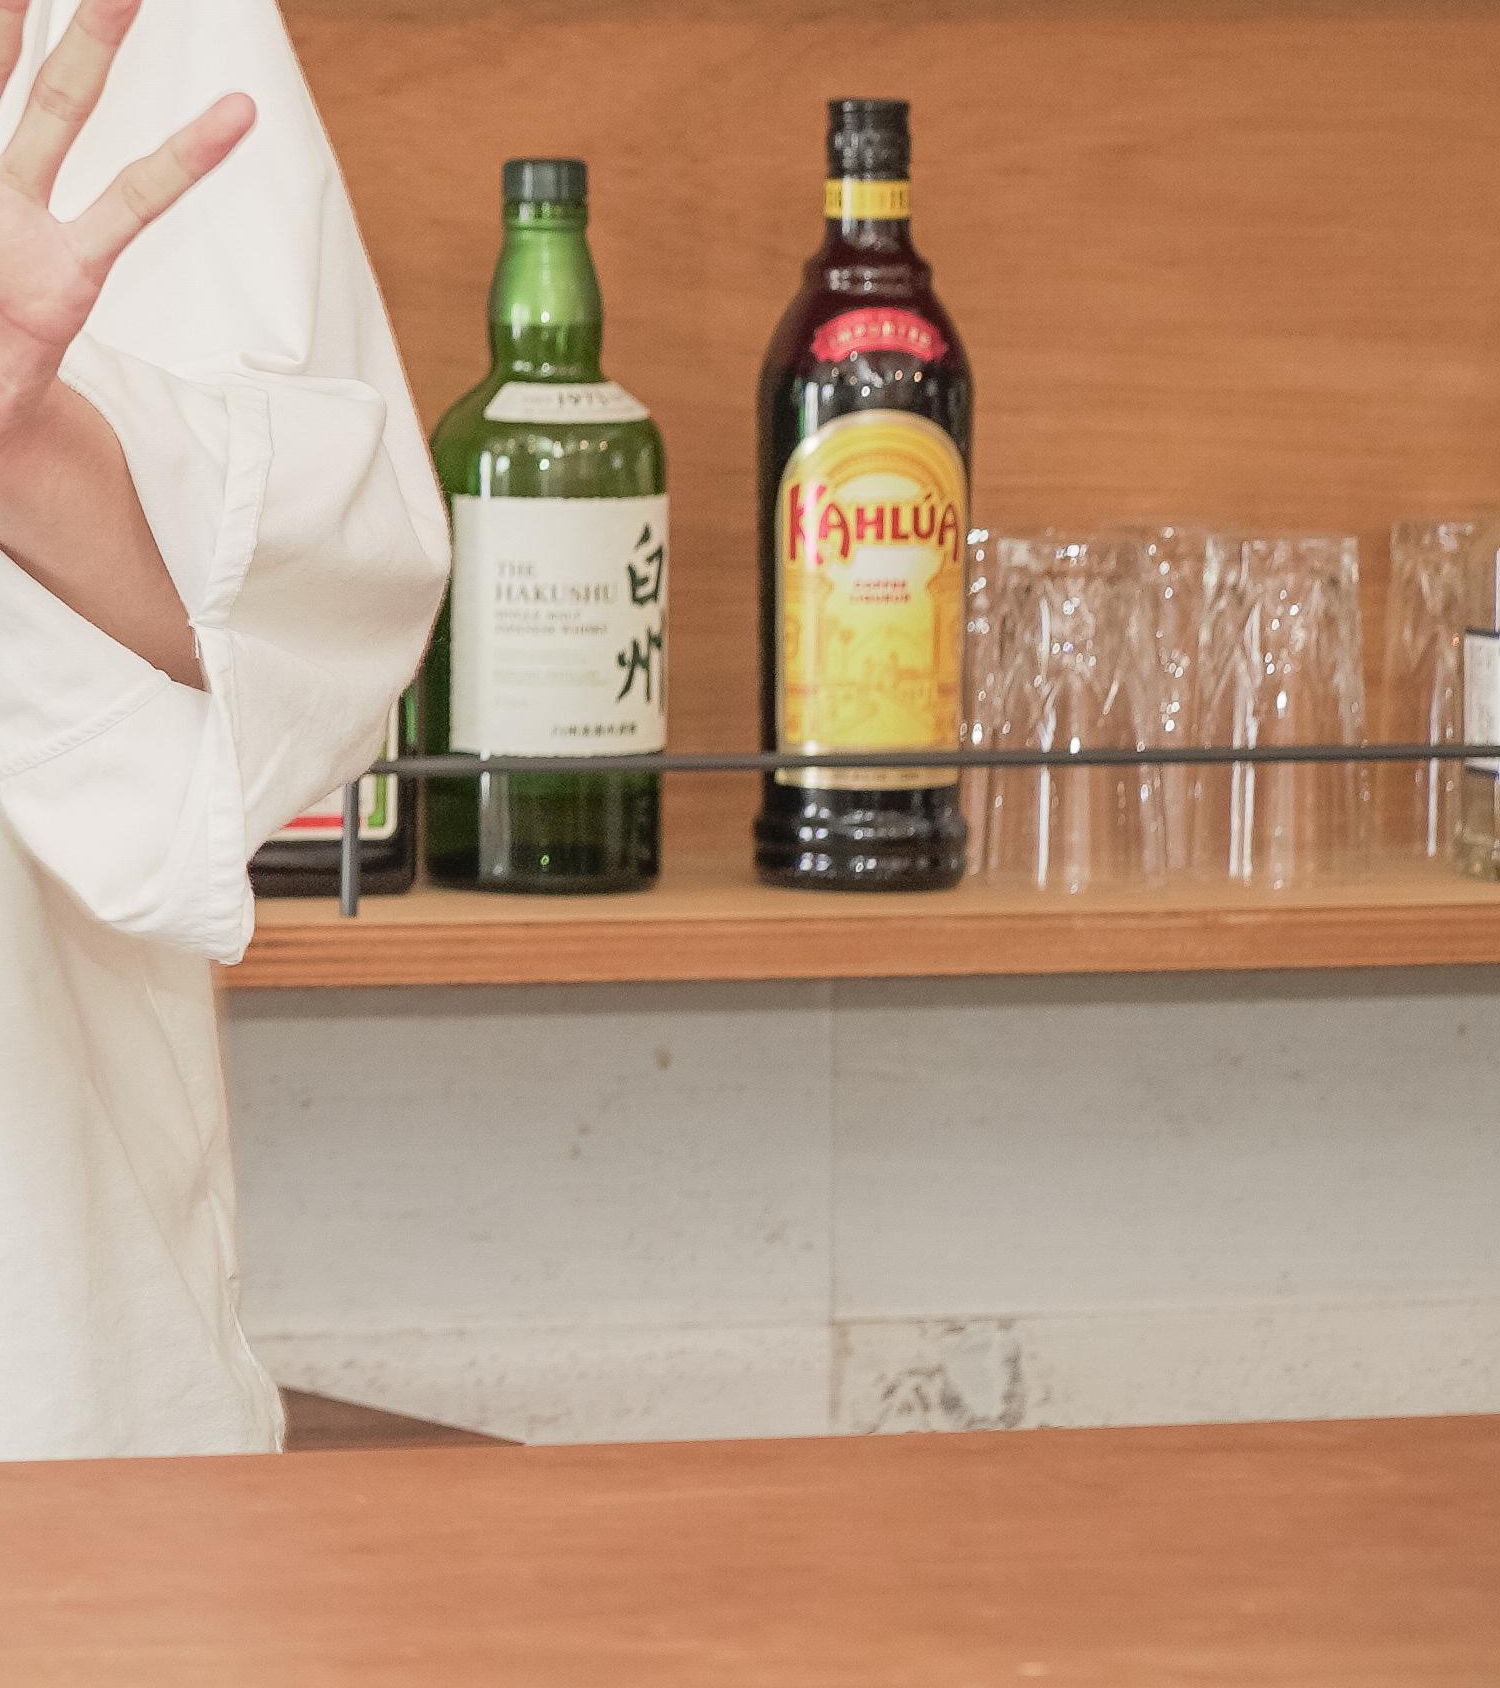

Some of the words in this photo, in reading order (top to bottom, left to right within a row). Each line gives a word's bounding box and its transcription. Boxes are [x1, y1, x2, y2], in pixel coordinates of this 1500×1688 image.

[789, 483, 959, 564] KAHLÚA
[495, 582, 618, 604] HAKUSHU
[498, 561, 536, 578] THE
[615, 522, 667, 716] 白州
